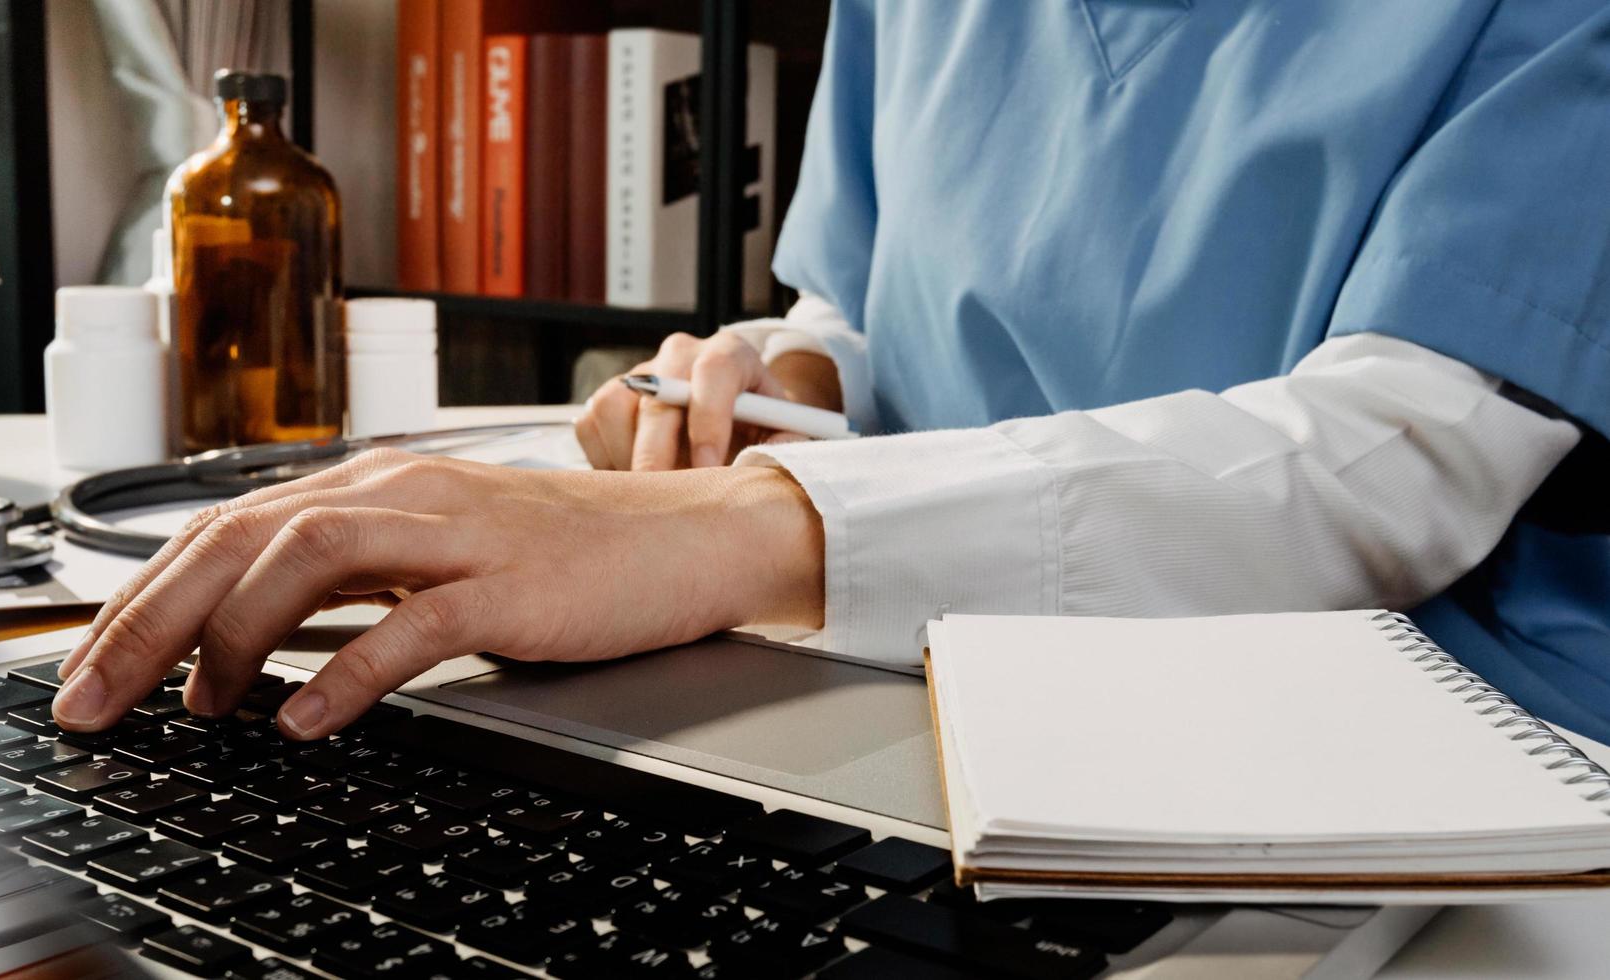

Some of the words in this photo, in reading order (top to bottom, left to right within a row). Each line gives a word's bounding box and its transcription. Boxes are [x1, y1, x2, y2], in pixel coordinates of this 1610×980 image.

[52, 753, 83, 762] P
[350, 748, 376, 757] M
[370, 802, 398, 812] H
[232, 814, 260, 824] U
[444, 826, 469, 835] G
[642, 830, 668, 842] C
[302, 839, 327, 848] Y
[172, 857, 200, 866] 7
[527, 853, 552, 862] F
[728, 856, 756, 867] X
[611, 876, 638, 888] D
[822, 883, 849, 896] Z
[462, 891, 488, 903] R
[702, 905, 728, 918] S
[324, 912, 351, 924] 5
[550, 920, 576, 933] E
[802, 933, 827, 946] A
[630, 948, 670, 967] W
